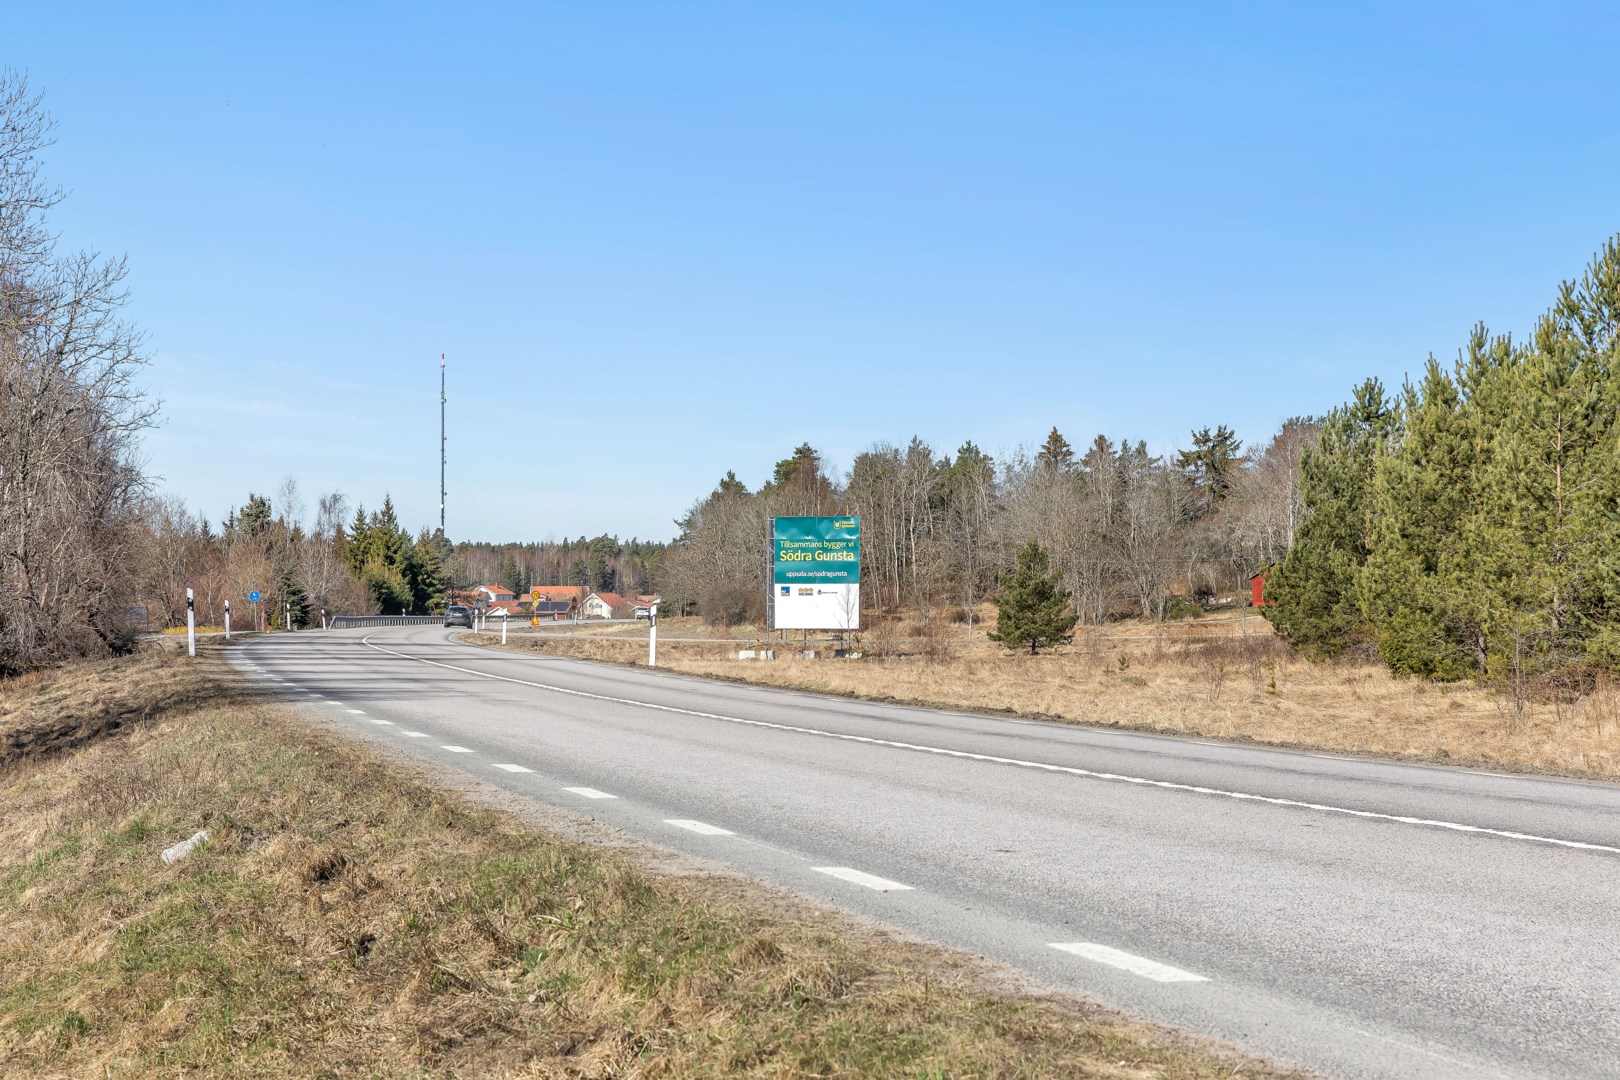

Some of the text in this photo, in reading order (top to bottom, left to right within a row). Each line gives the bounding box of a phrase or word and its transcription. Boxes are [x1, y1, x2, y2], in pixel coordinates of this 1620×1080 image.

[824, 541, 846, 549] bygger
[780, 550, 854, 561] Södra Gunsta
